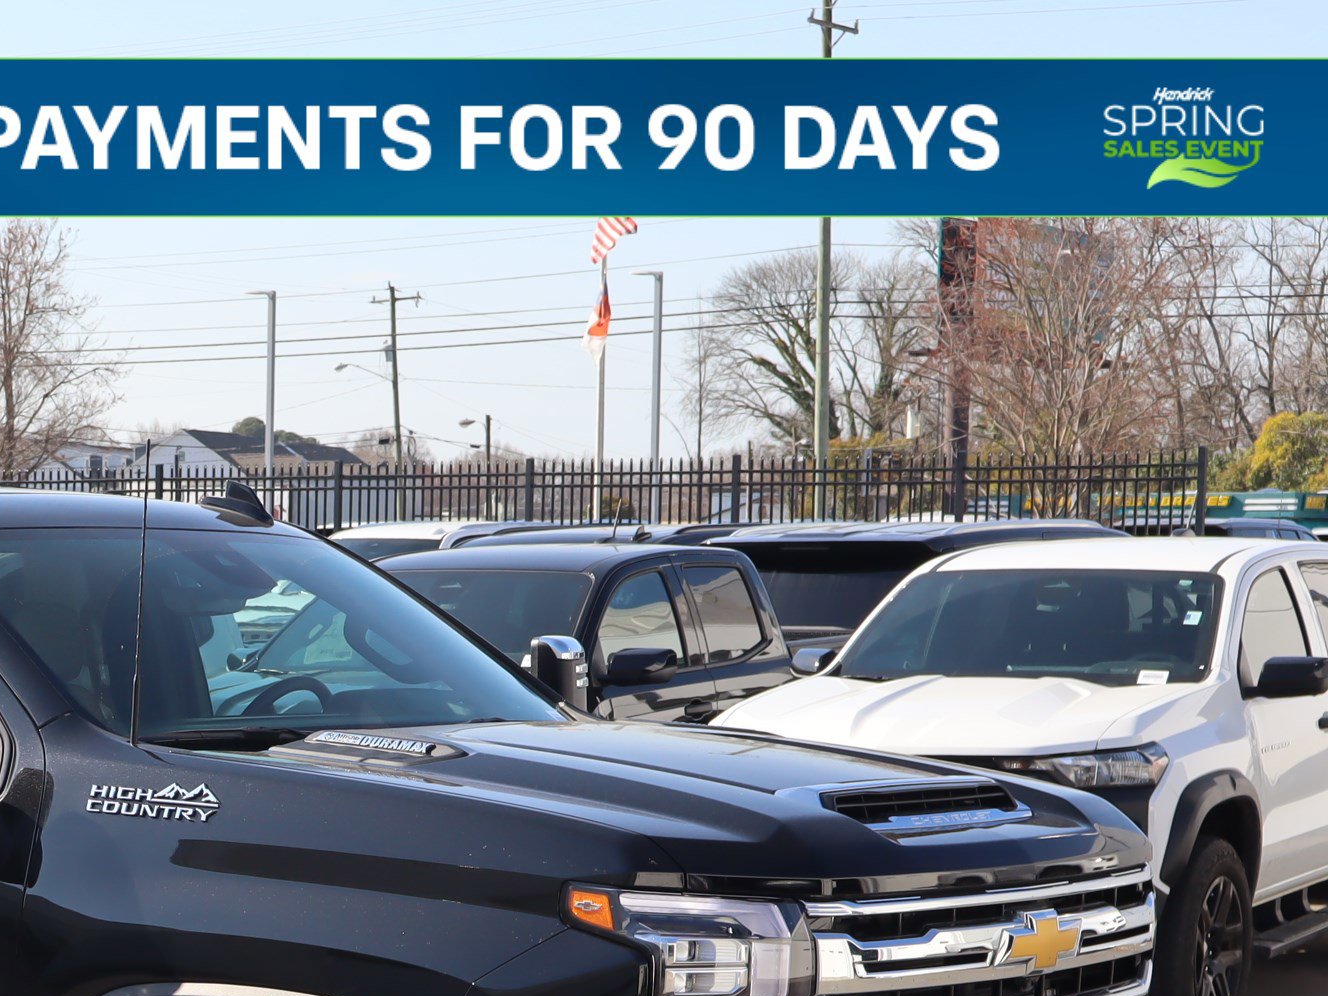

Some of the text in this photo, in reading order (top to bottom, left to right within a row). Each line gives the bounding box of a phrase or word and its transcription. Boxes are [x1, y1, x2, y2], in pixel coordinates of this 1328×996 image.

[1160, 495, 1231, 507] BRAES
[359, 736, 430, 753] DURAMAX
[89, 784, 153, 801] HIGH
[85, 798, 215, 822] COUNTRY
[910, 811, 991, 825] CHEVROLET
